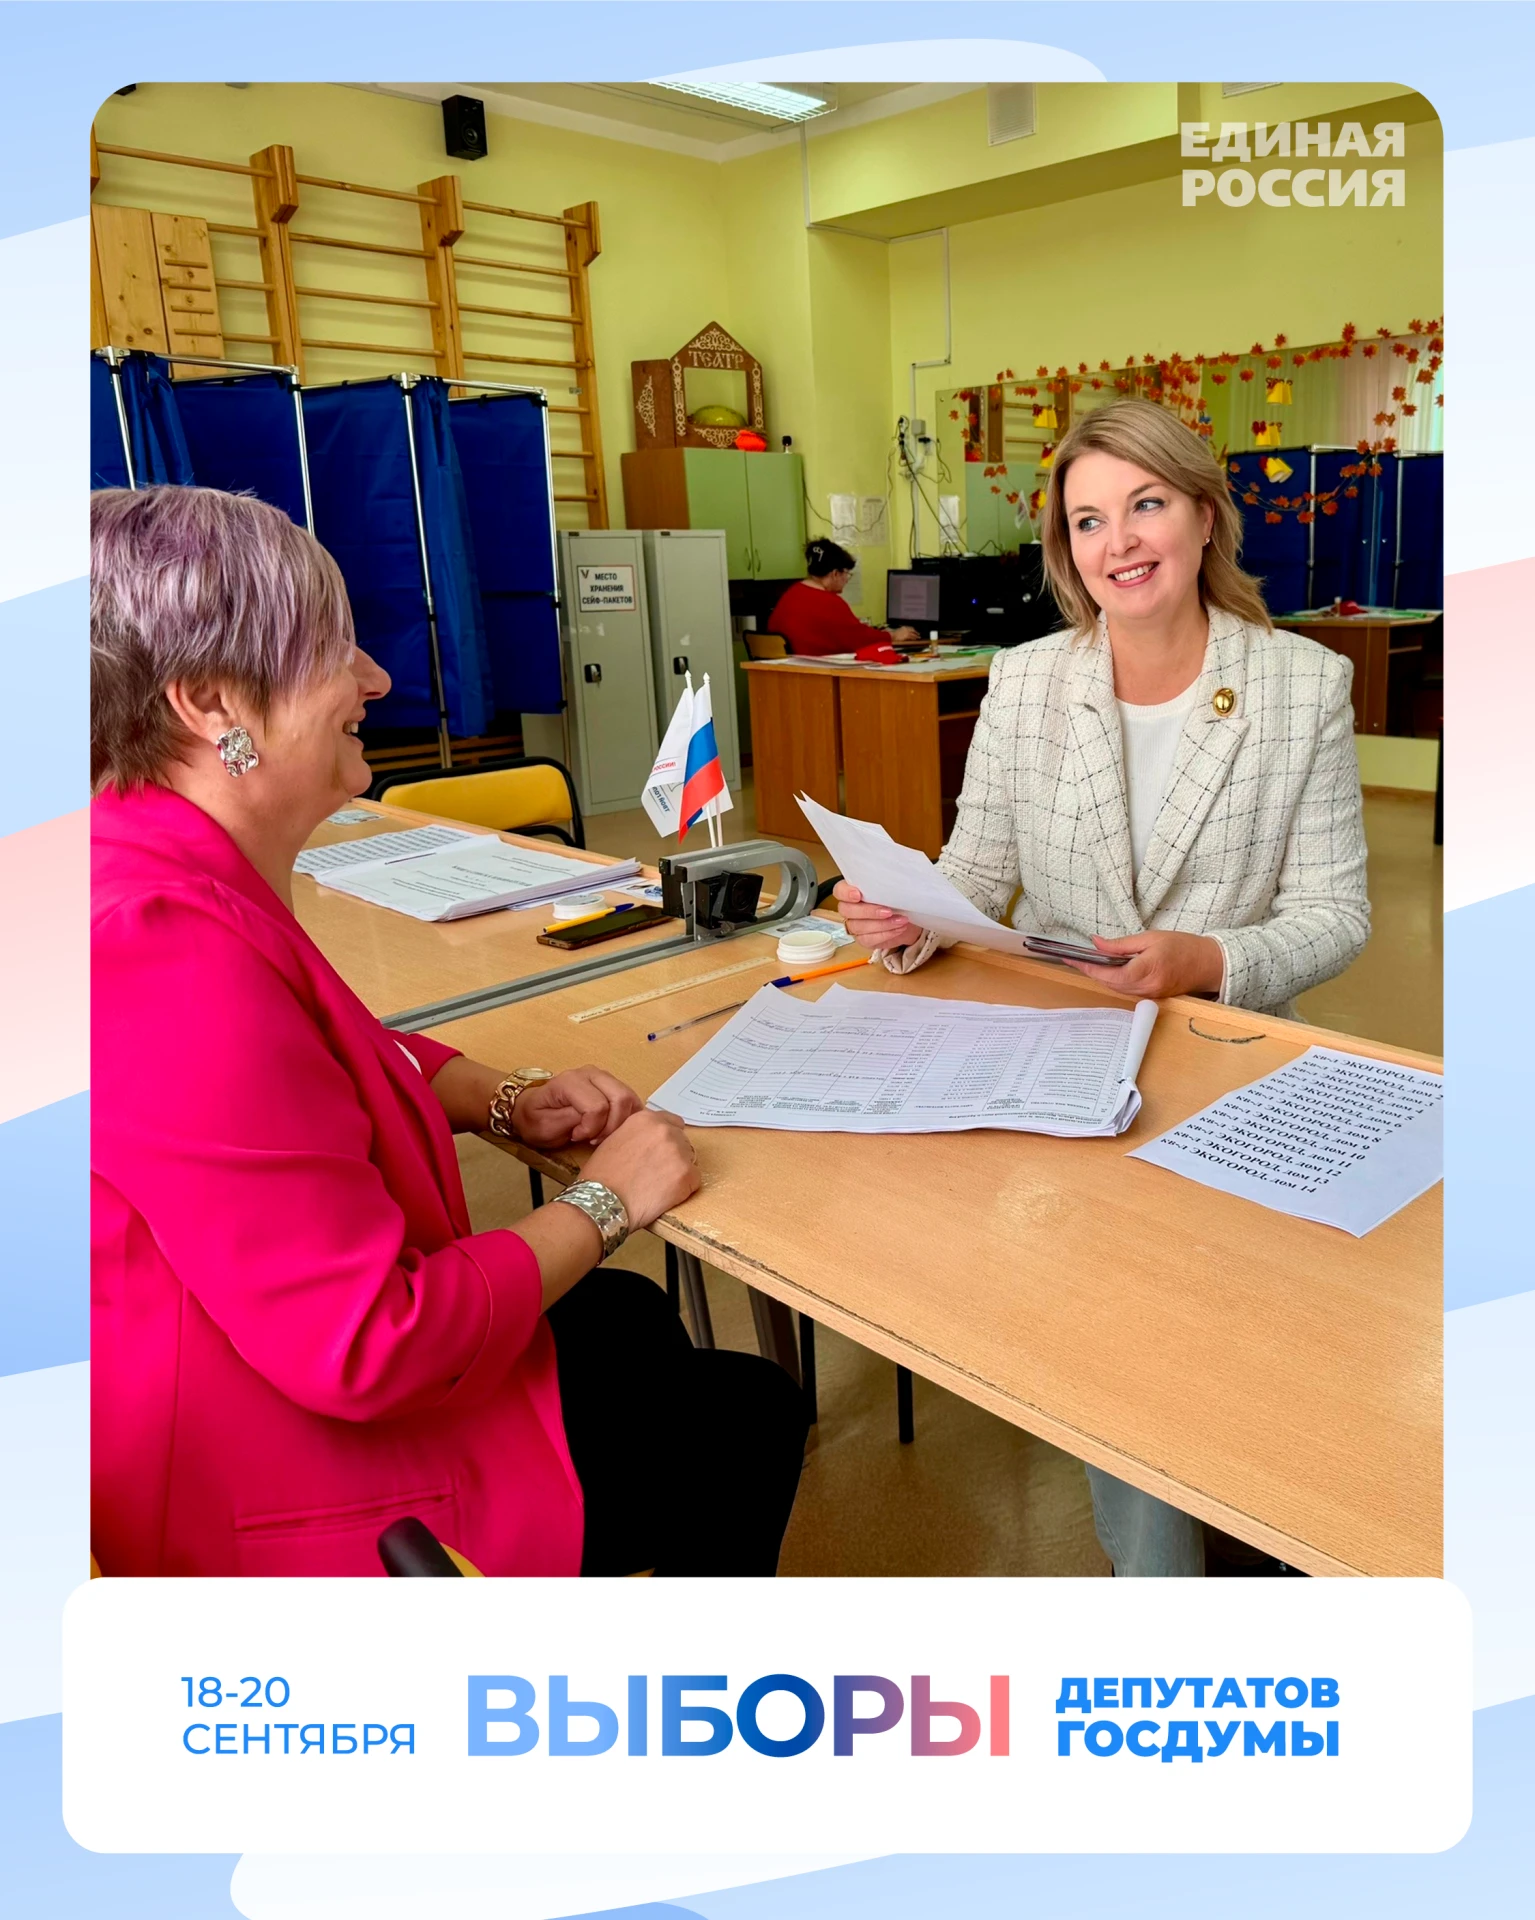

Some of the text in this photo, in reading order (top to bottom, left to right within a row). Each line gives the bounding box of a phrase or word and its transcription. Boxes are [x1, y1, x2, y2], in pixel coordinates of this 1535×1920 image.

[590, 584, 624, 593] ХРАНЕНИЯ
[594, 572, 617, 581] МЕСТО
[582, 595, 633, 605] СЕЙФ-ПАКЕТОВ
[1320, 1074, 1395, 1098] ЭКОГОРОД,
[1398, 1096, 1423, 1105] дом
[1330, 1068, 1405, 1091] ЭКОГОРОД,
[1407, 1088, 1432, 1098] дом
[1341, 1060, 1415, 1083] ЭКОГОРОД,
[1417, 1080, 1442, 1089] дом
[1288, 1092, 1363, 1119] ЭКОГОРОД,
[1366, 1116, 1392, 1125] дом
[1299, 1086, 1374, 1112] ЭКОГОРОД,
[1376, 1109, 1402, 1118] дом
[1309, 1080, 1384, 1105] ЭКОГОРОД,
[1387, 1102, 1413, 1111] дом
[1253, 1112, 1329, 1140] ЭКОГОРОД,
[1332, 1138, 1358, 1148] дом
[1265, 1106, 1340, 1133] ЭКОГОРОД,
[1343, 1130, 1369, 1140] дом
[1276, 1099, 1352, 1126] ЭКОГОРОД,
[1355, 1123, 1380, 1132] дом
[1216, 1133, 1293, 1164] ЭКОГОРОД,
[1296, 1162, 1322, 1172] дом
[1325, 1168, 1342, 1177] 12
[1228, 1126, 1305, 1156] ЭКОГОРОД,
[1308, 1154, 1335, 1164] дом
[1337, 1160, 1352, 1168] 11
[1241, 1119, 1317, 1148] ЭКОГОРОД,
[1320, 1146, 1346, 1156] дом
[1349, 1152, 1366, 1160] 10
[1190, 1148, 1267, 1181] ЭКОГОРОД,
[1270, 1178, 1297, 1189] дом
[1300, 1185, 1317, 1194] 14
[1203, 1141, 1280, 1172] ЭКОГОРОД,
[1283, 1170, 1310, 1180] дом
[1312, 1176, 1330, 1185] 13
